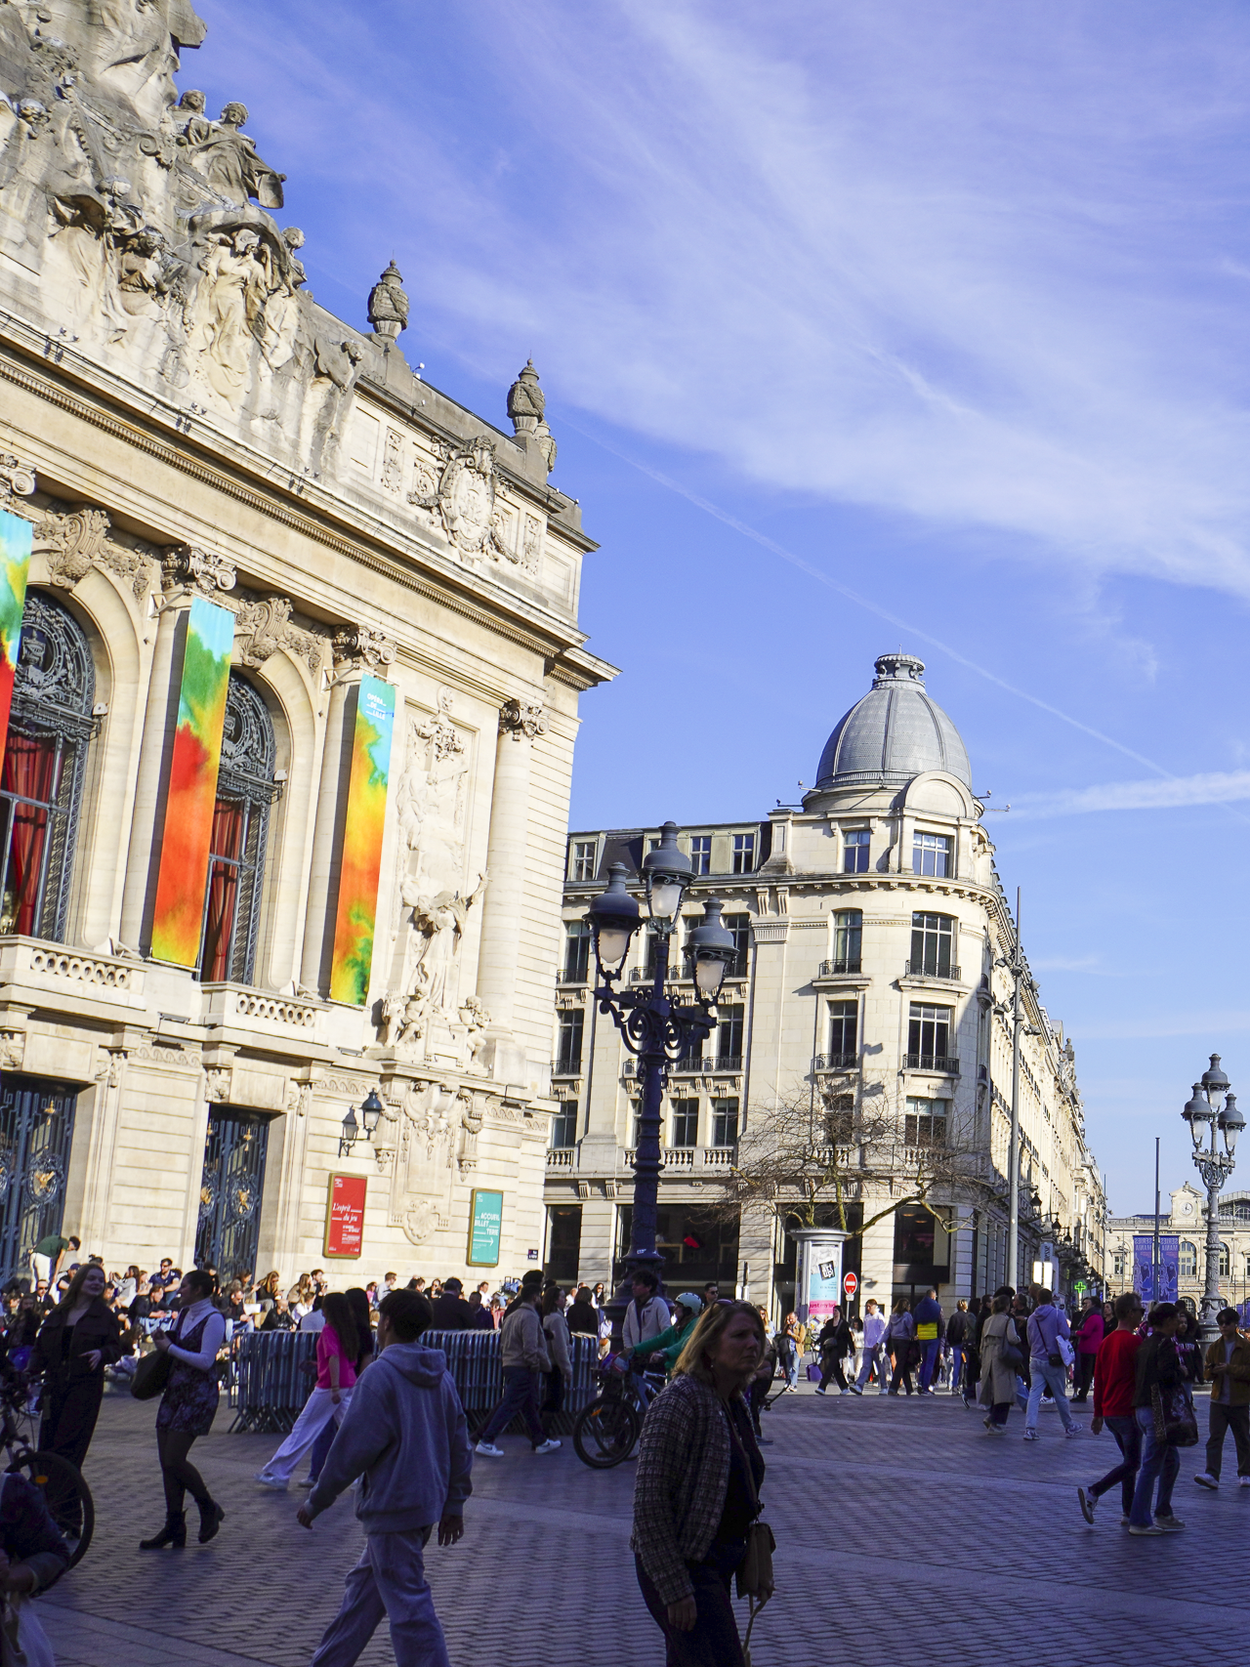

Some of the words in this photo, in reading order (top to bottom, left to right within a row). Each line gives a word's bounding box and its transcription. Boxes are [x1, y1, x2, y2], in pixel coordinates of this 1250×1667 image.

[481, 1213, 500, 1221] ACCUEIL
[475, 1220, 489, 1228] BILLET
[486, 1228, 499, 1236] TERIE
